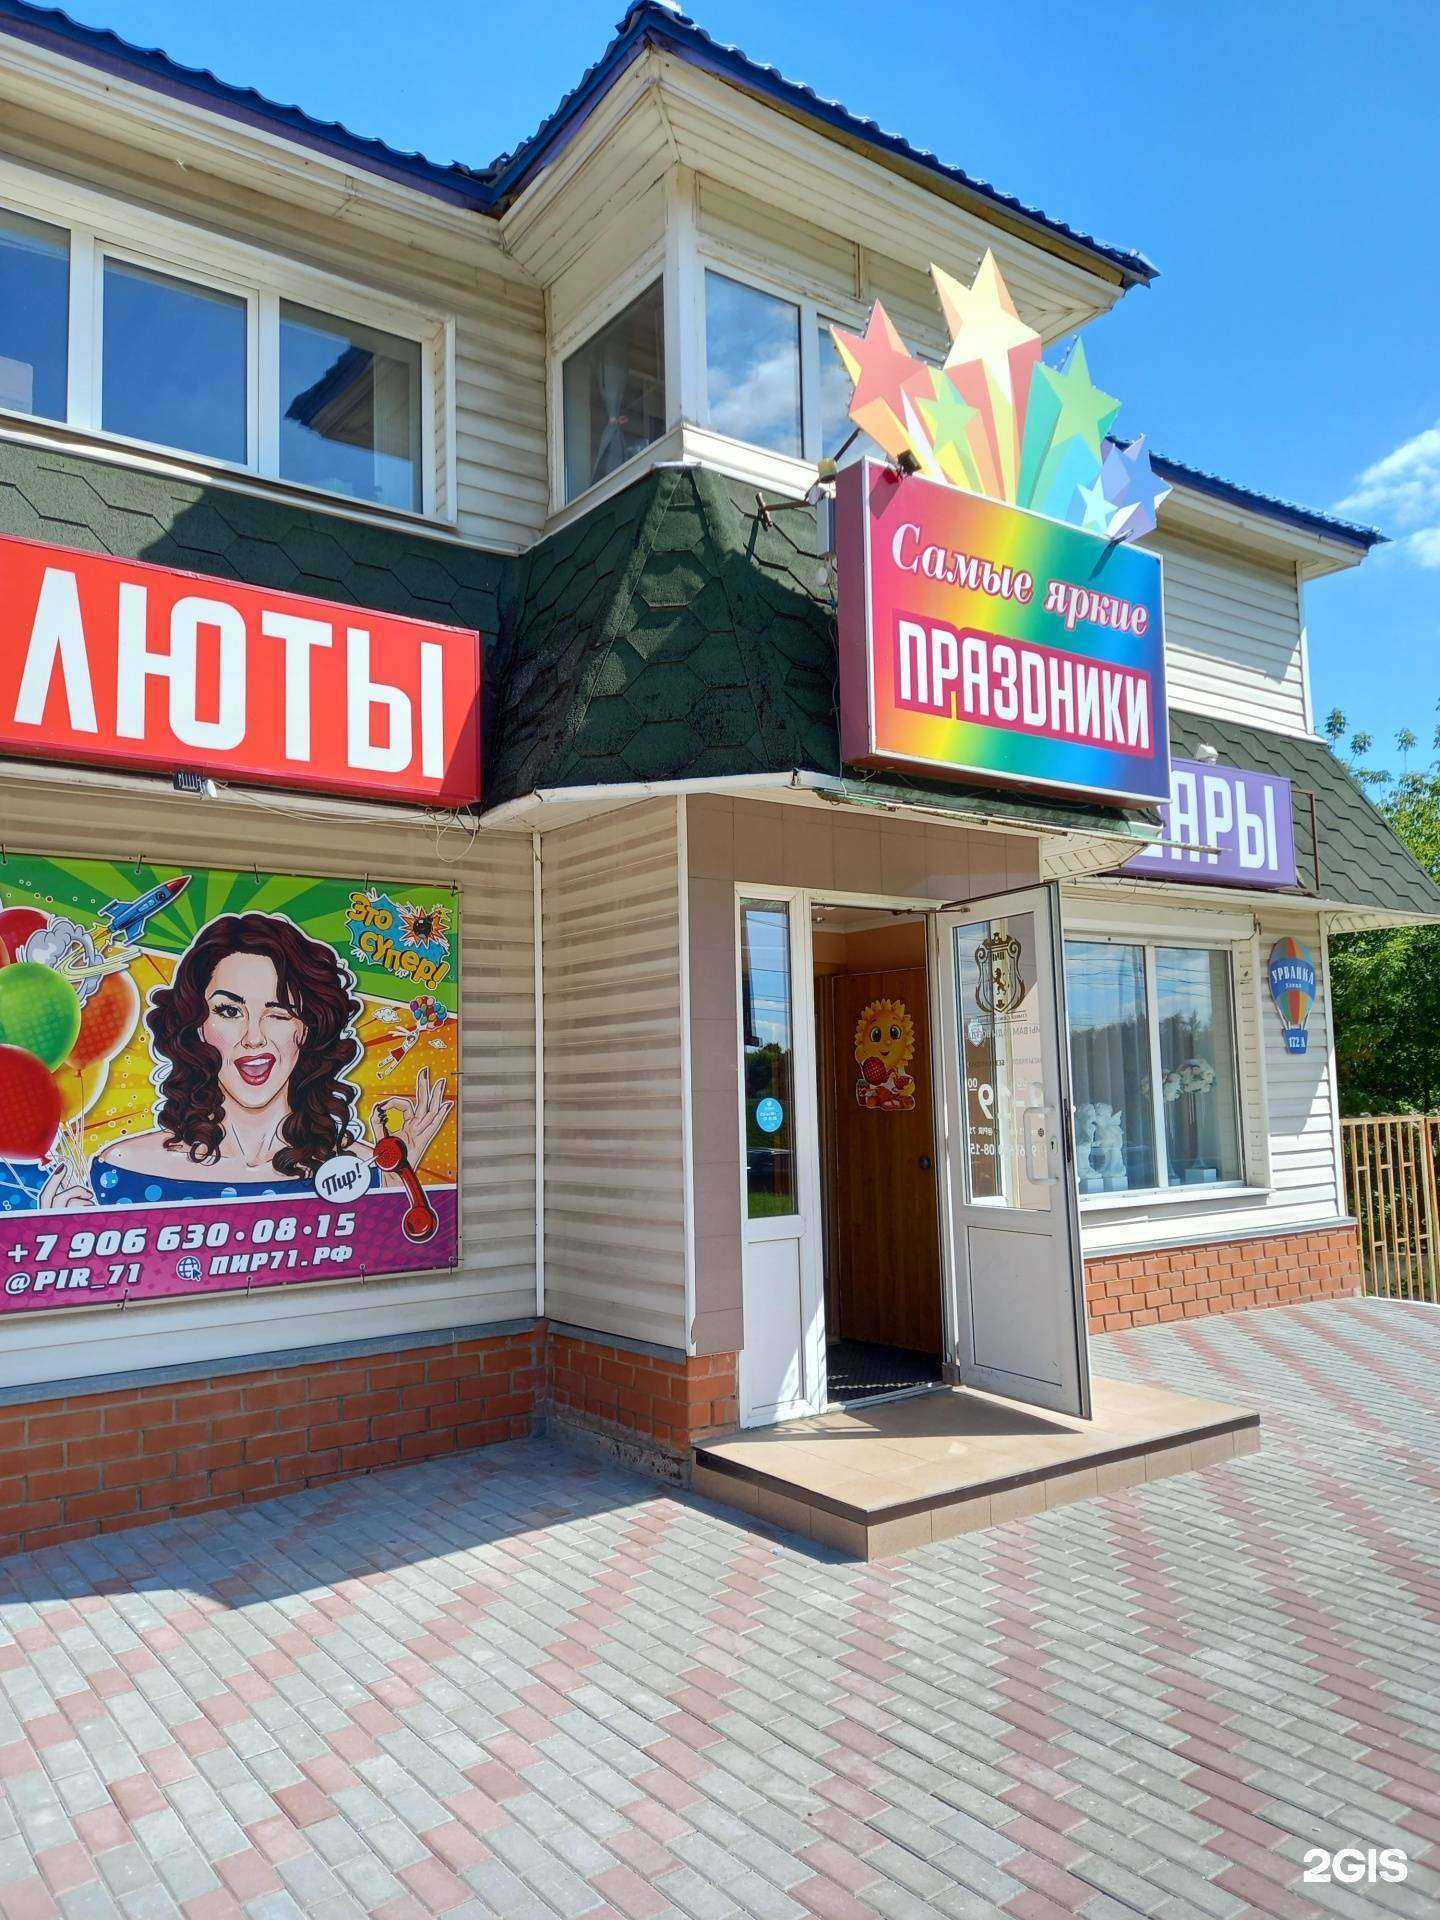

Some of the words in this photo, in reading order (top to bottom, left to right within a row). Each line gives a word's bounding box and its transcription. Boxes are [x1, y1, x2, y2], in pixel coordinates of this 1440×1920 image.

[892, 523, 1032, 602] Самые
[1045, 581, 1149, 634] яркие
[14, 567, 444, 779] ЛЮТЫ
[898, 620, 1150, 749] ПРАЗДНИКИ
[1140, 770, 1278, 871] АРЫ
[347, 893, 393, 930] Это
[321, 1162, 363, 1196] Пир!
[5, 1263, 141, 1295] @PIR_71
[7, 1234, 59, 1263] +7
[68, 1227, 148, 1259] 906
